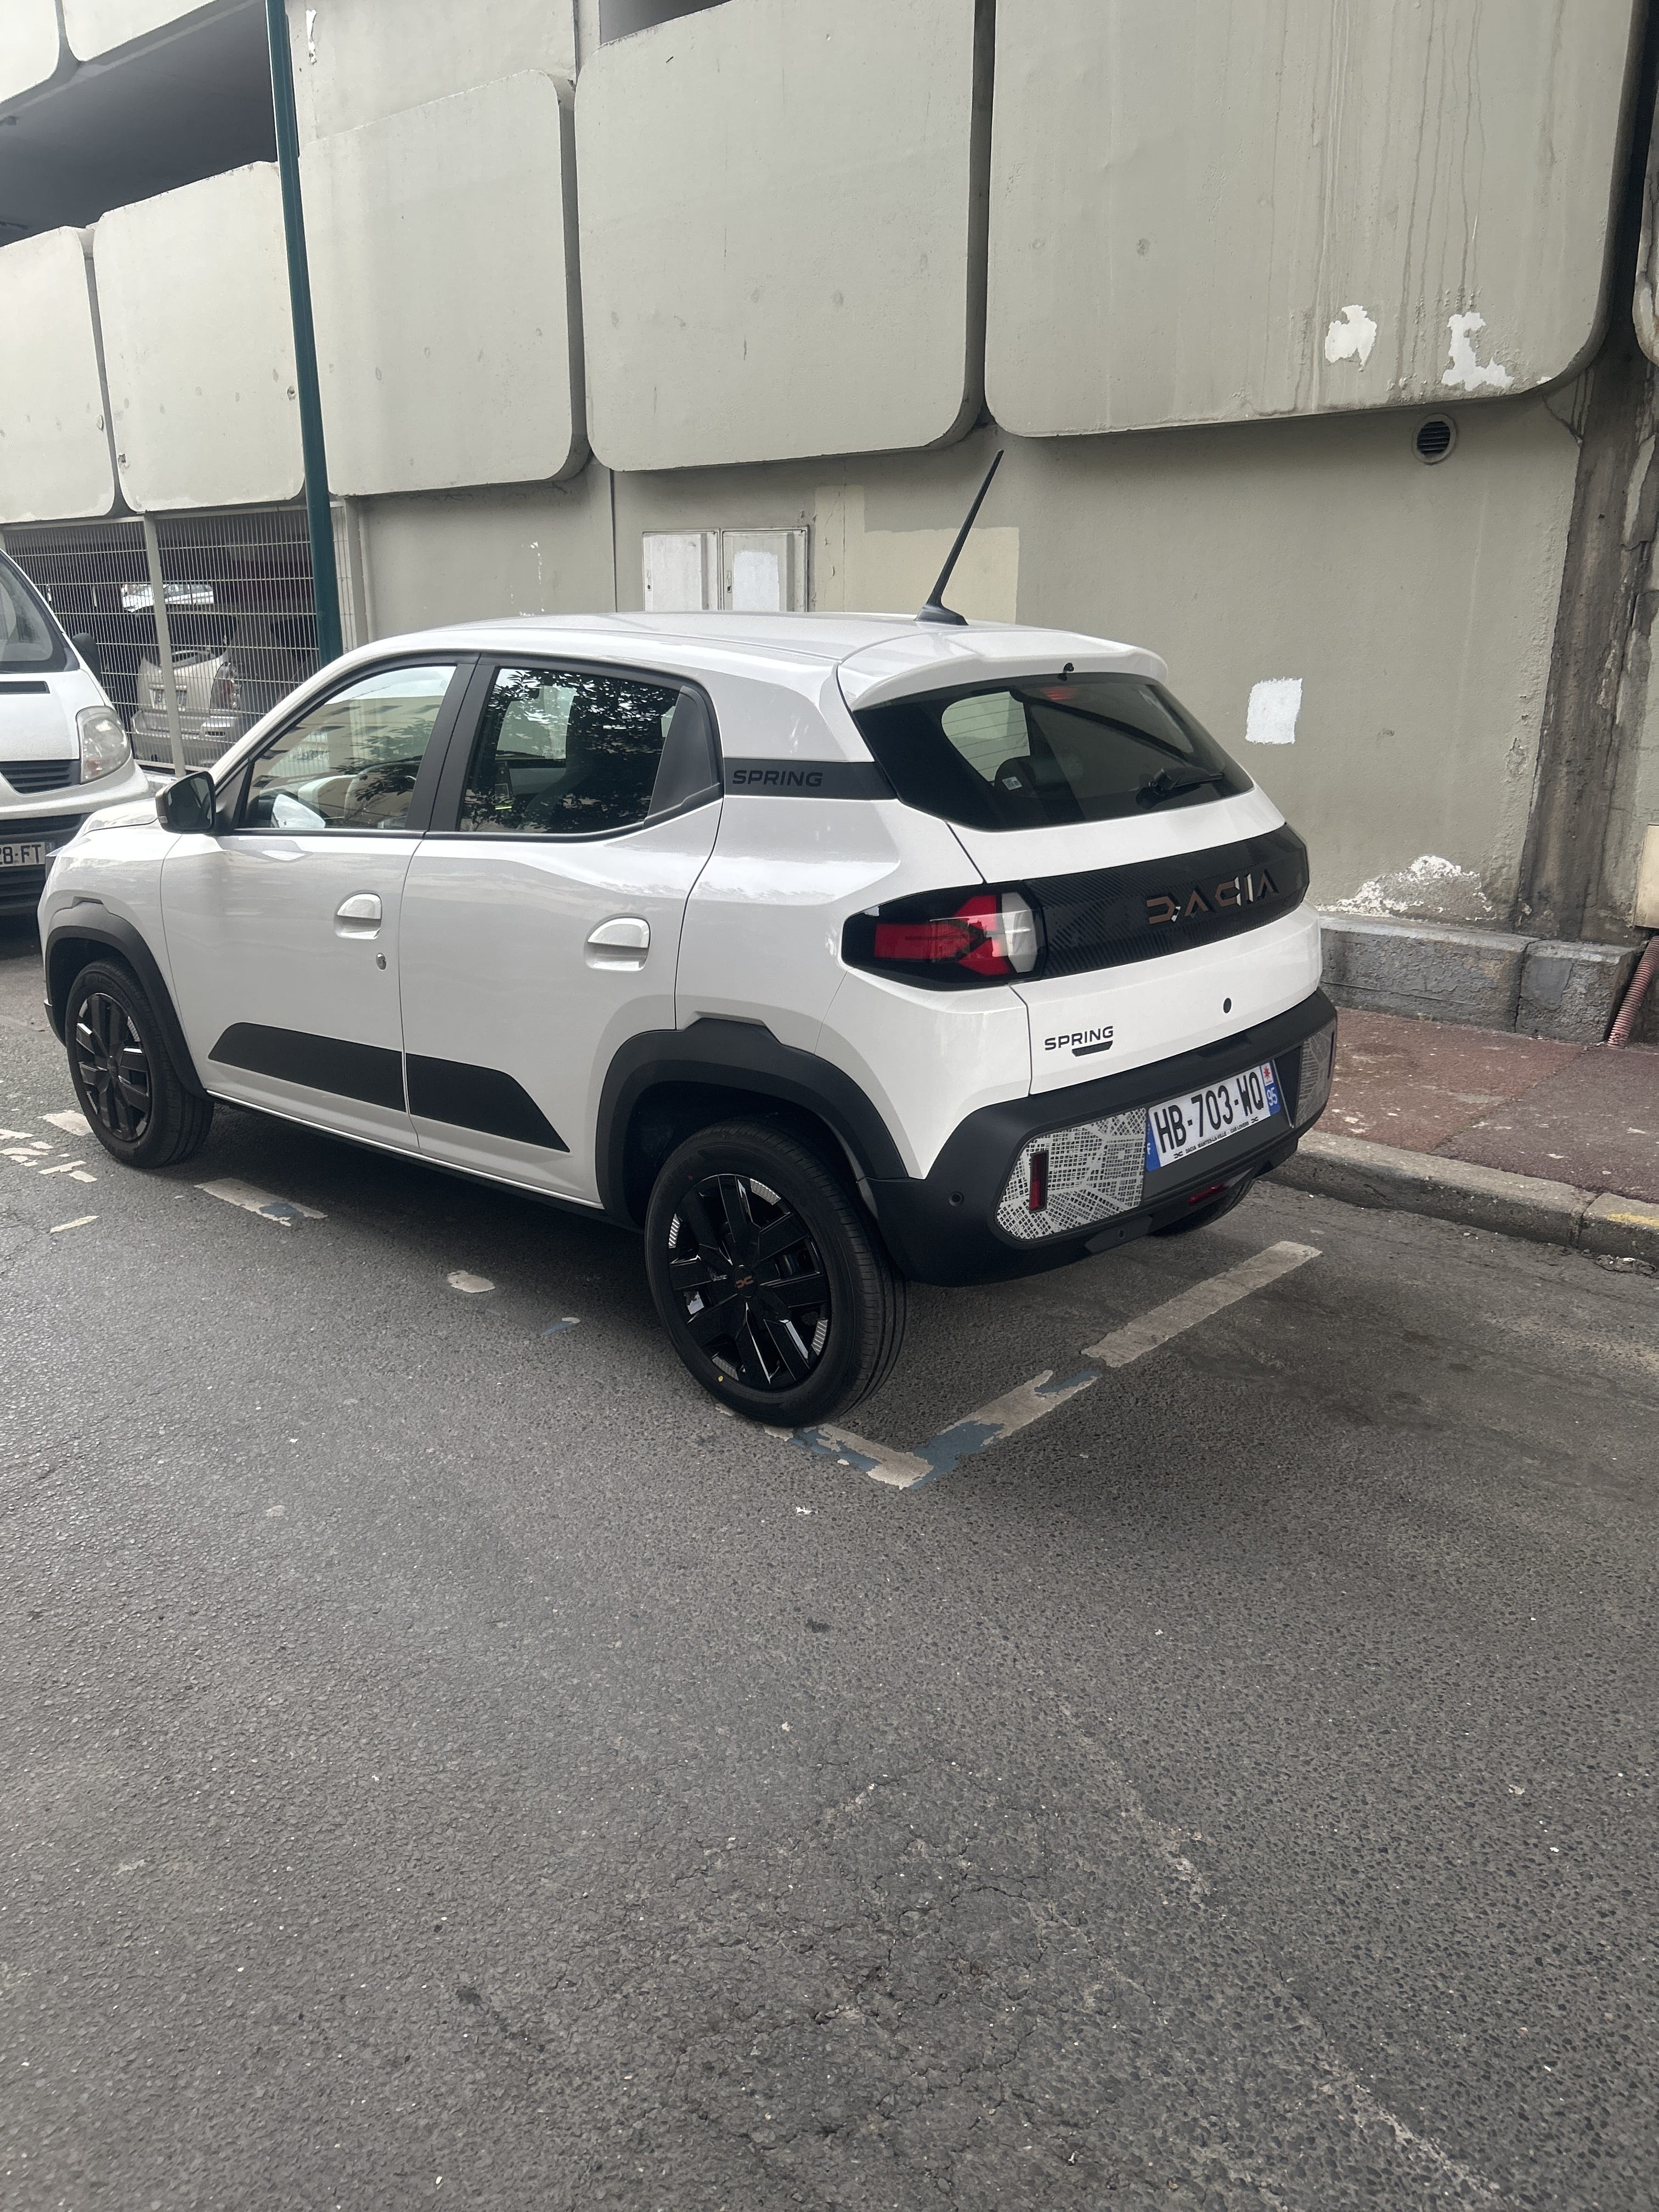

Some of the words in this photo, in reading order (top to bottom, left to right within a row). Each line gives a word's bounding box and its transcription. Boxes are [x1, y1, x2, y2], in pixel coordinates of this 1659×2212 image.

[732, 770, 823, 787] SPRING
[0, 844, 41, 865] 8-FT
[1146, 868, 1279, 924] DACIA
[1044, 1025, 1113, 1051] SPRING
[1266, 1087, 1278, 1106] 95
[1154, 1071, 1264, 1154] HB-703-WQ
